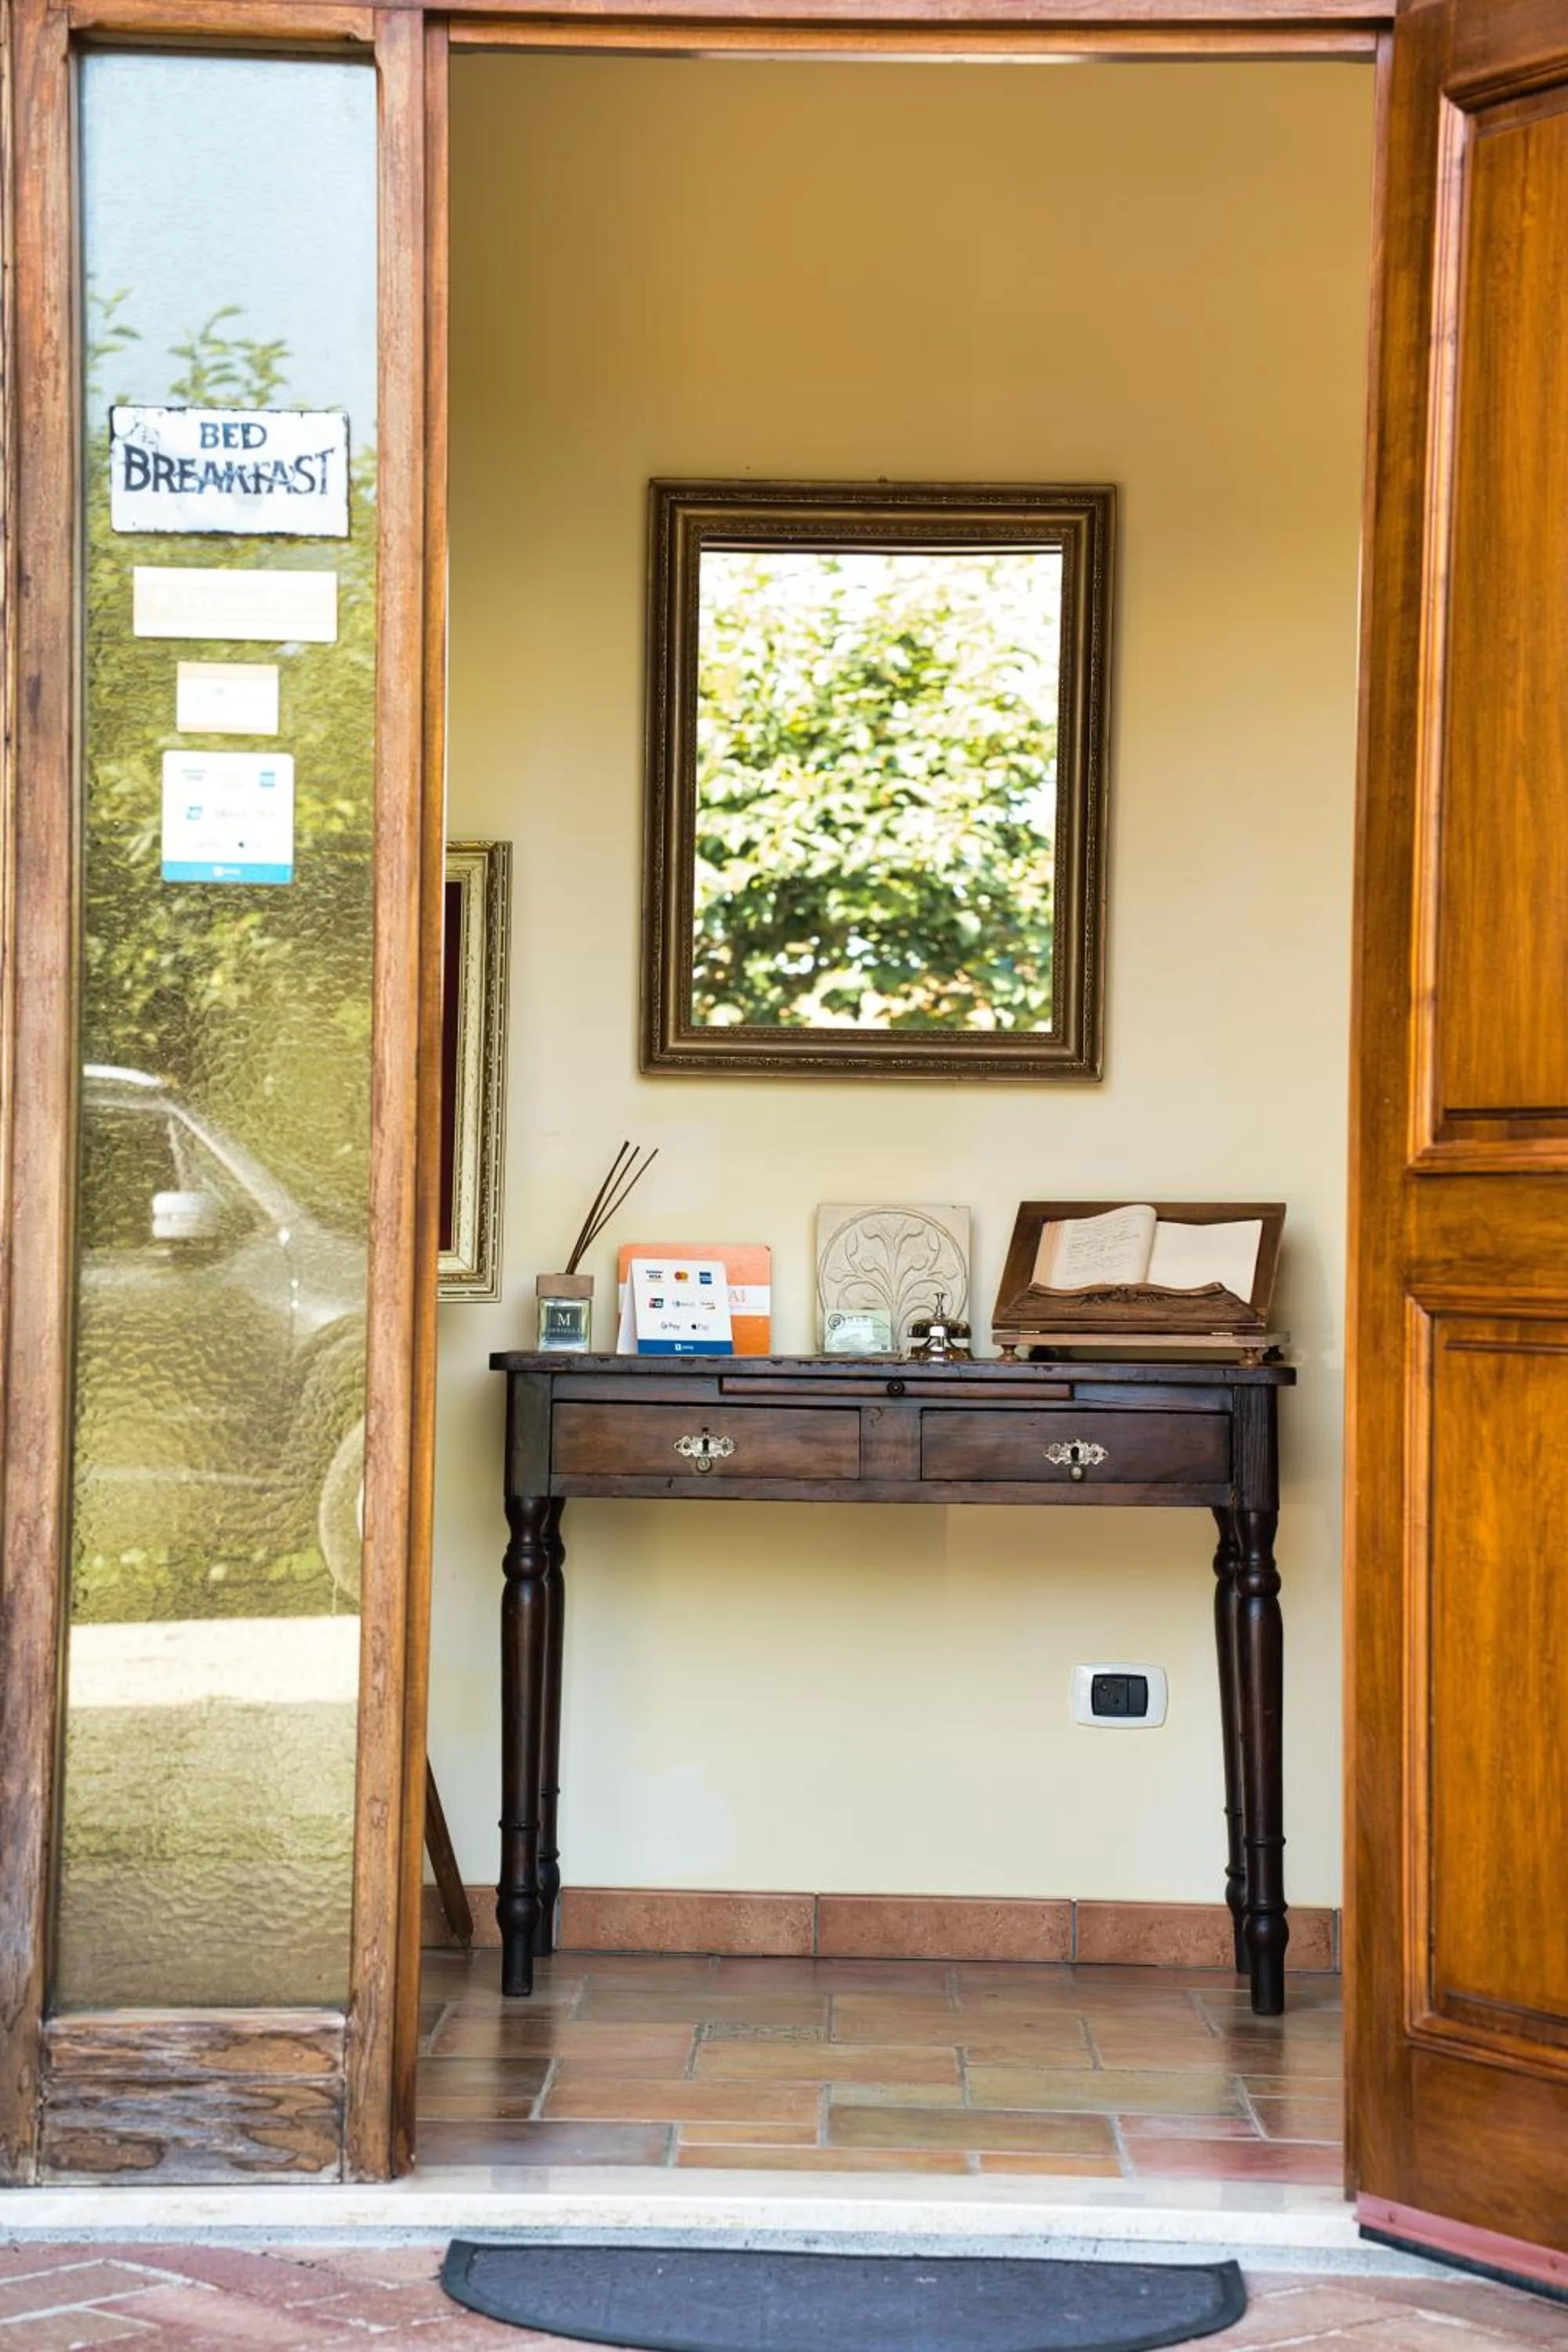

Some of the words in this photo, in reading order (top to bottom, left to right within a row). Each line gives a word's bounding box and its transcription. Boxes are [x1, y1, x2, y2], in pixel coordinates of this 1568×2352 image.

[200, 422, 267, 449] BED
[123, 443, 335, 495] BREAKFAST
[557, 1312, 571, 1327] M
